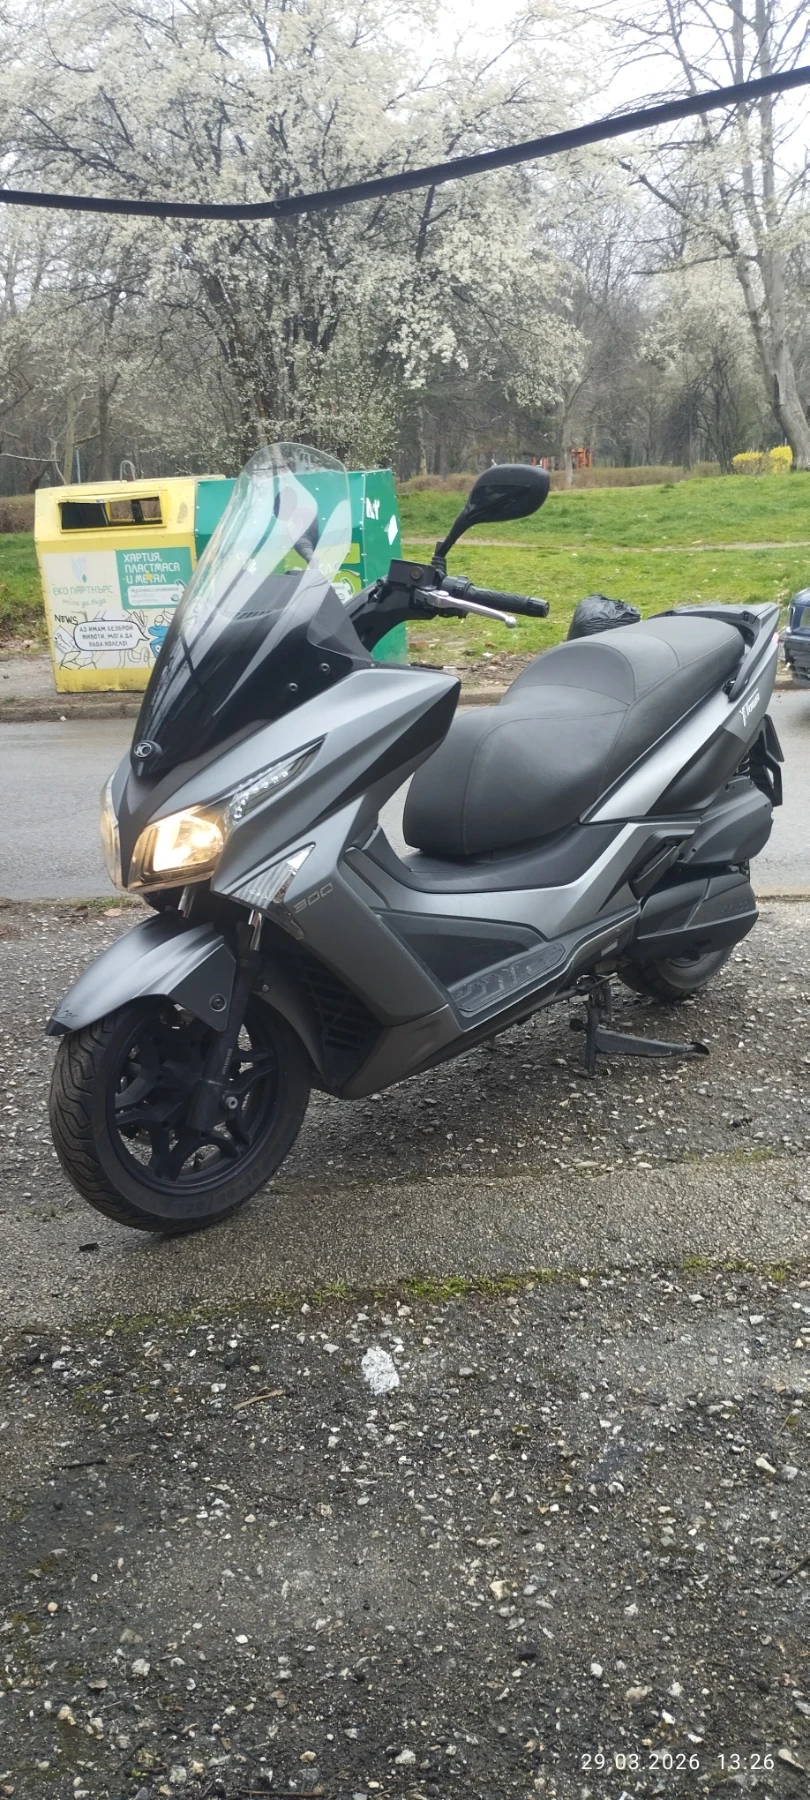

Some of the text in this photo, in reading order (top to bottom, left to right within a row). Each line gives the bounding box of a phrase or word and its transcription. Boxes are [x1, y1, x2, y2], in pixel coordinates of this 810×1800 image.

[123, 552, 162, 562] ХАРТИЯ,
[124, 562, 180, 573] ПЛАСТМАСА
[53, 585, 113, 595] ЕКО ПАРТНЪРС
[54, 614, 78, 625] NEWS
[293, 882, 333, 914] 300
